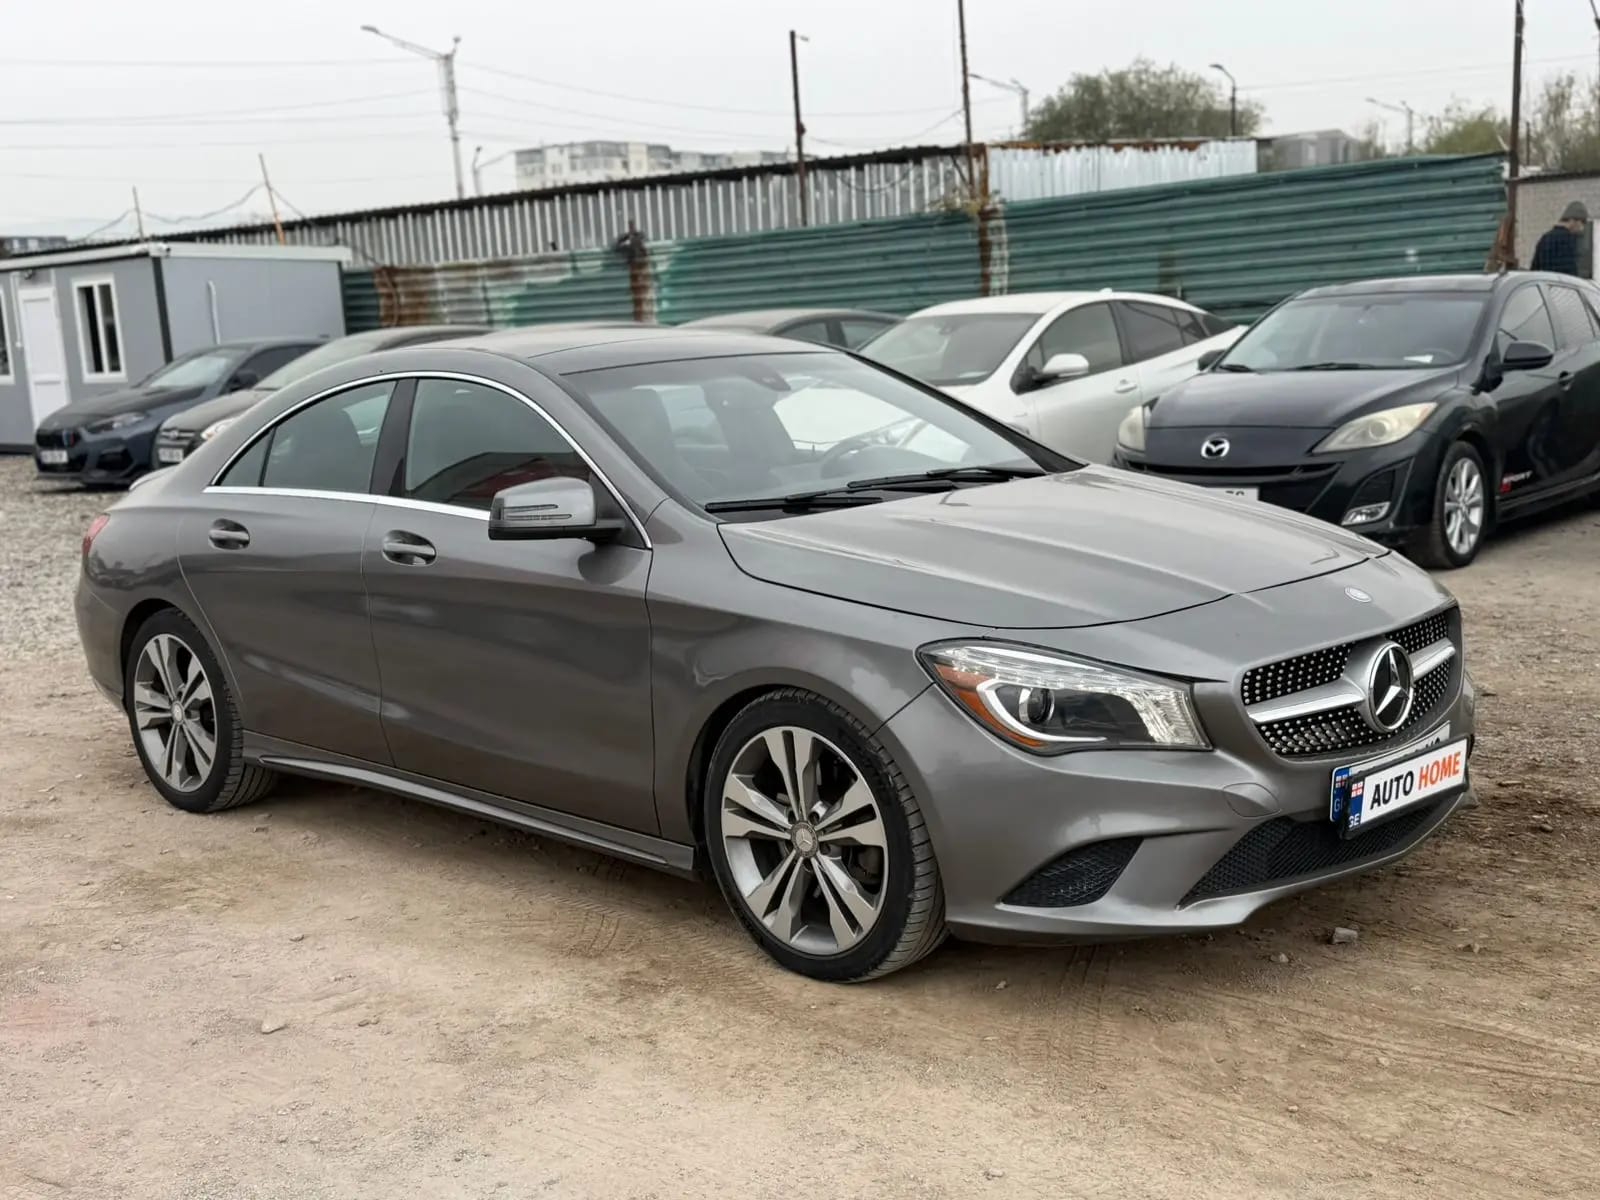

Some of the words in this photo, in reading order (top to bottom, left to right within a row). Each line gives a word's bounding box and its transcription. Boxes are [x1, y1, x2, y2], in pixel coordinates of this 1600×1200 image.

[1370, 771, 1414, 809] AUTO
[1418, 752, 1461, 790] HOME
[1348, 813, 1360, 828] GE
